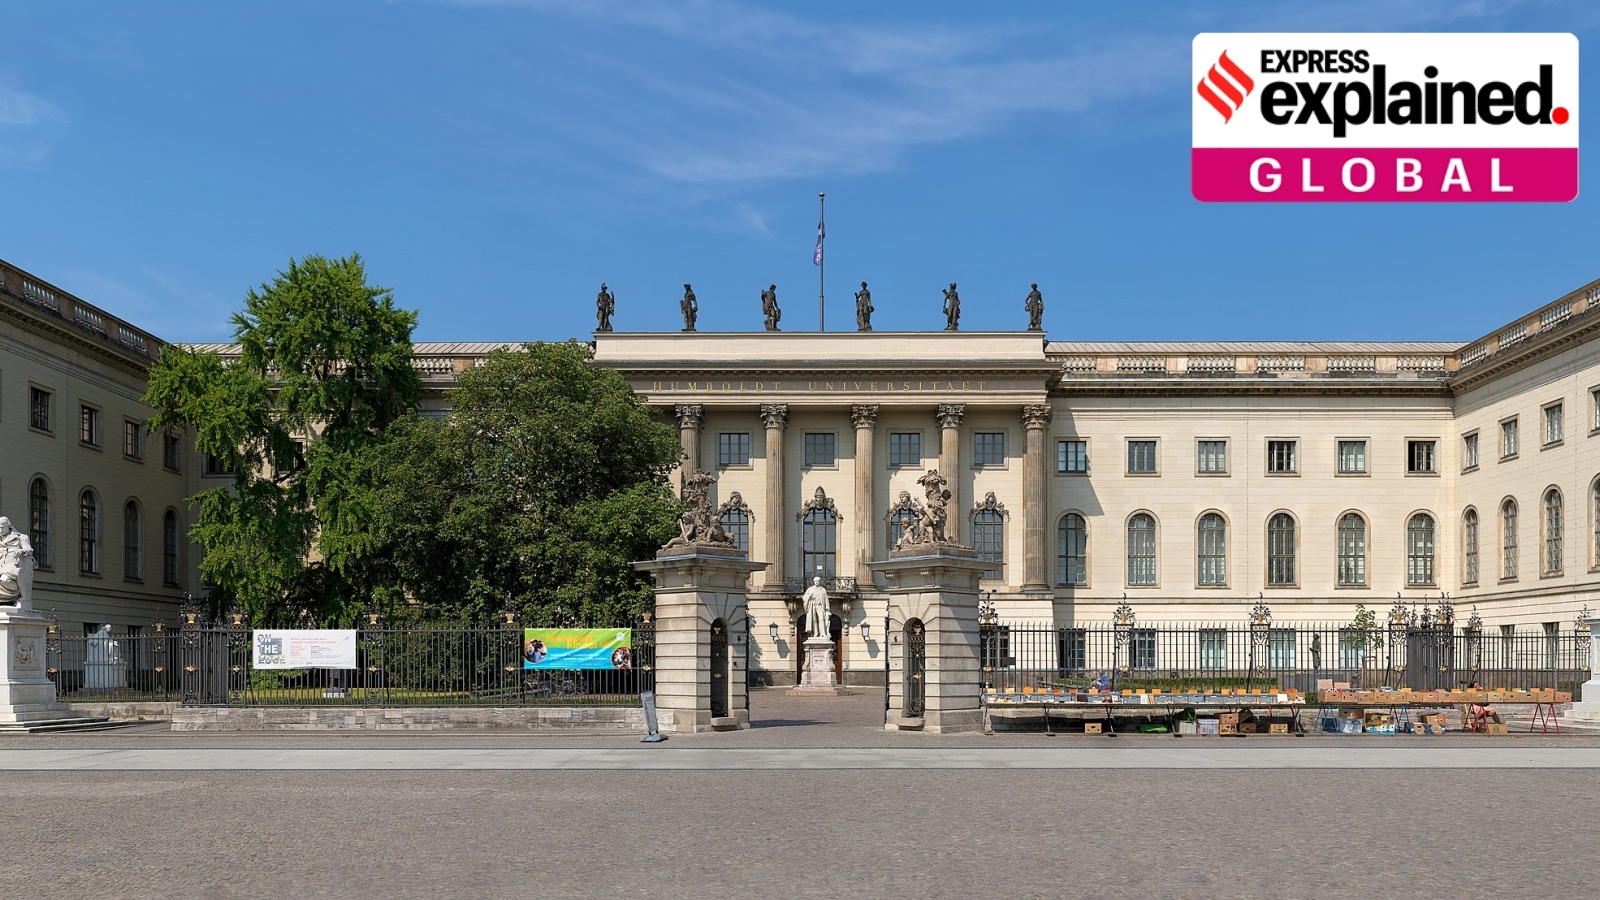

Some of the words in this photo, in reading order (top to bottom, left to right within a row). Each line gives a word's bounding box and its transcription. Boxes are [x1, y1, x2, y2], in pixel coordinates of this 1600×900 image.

[653, 381, 781, 392] HUMBOLDT
[808, 381, 986, 392] UNIVERSITAET
[257, 633, 272, 643] ON
[257, 644, 278, 653] THE
